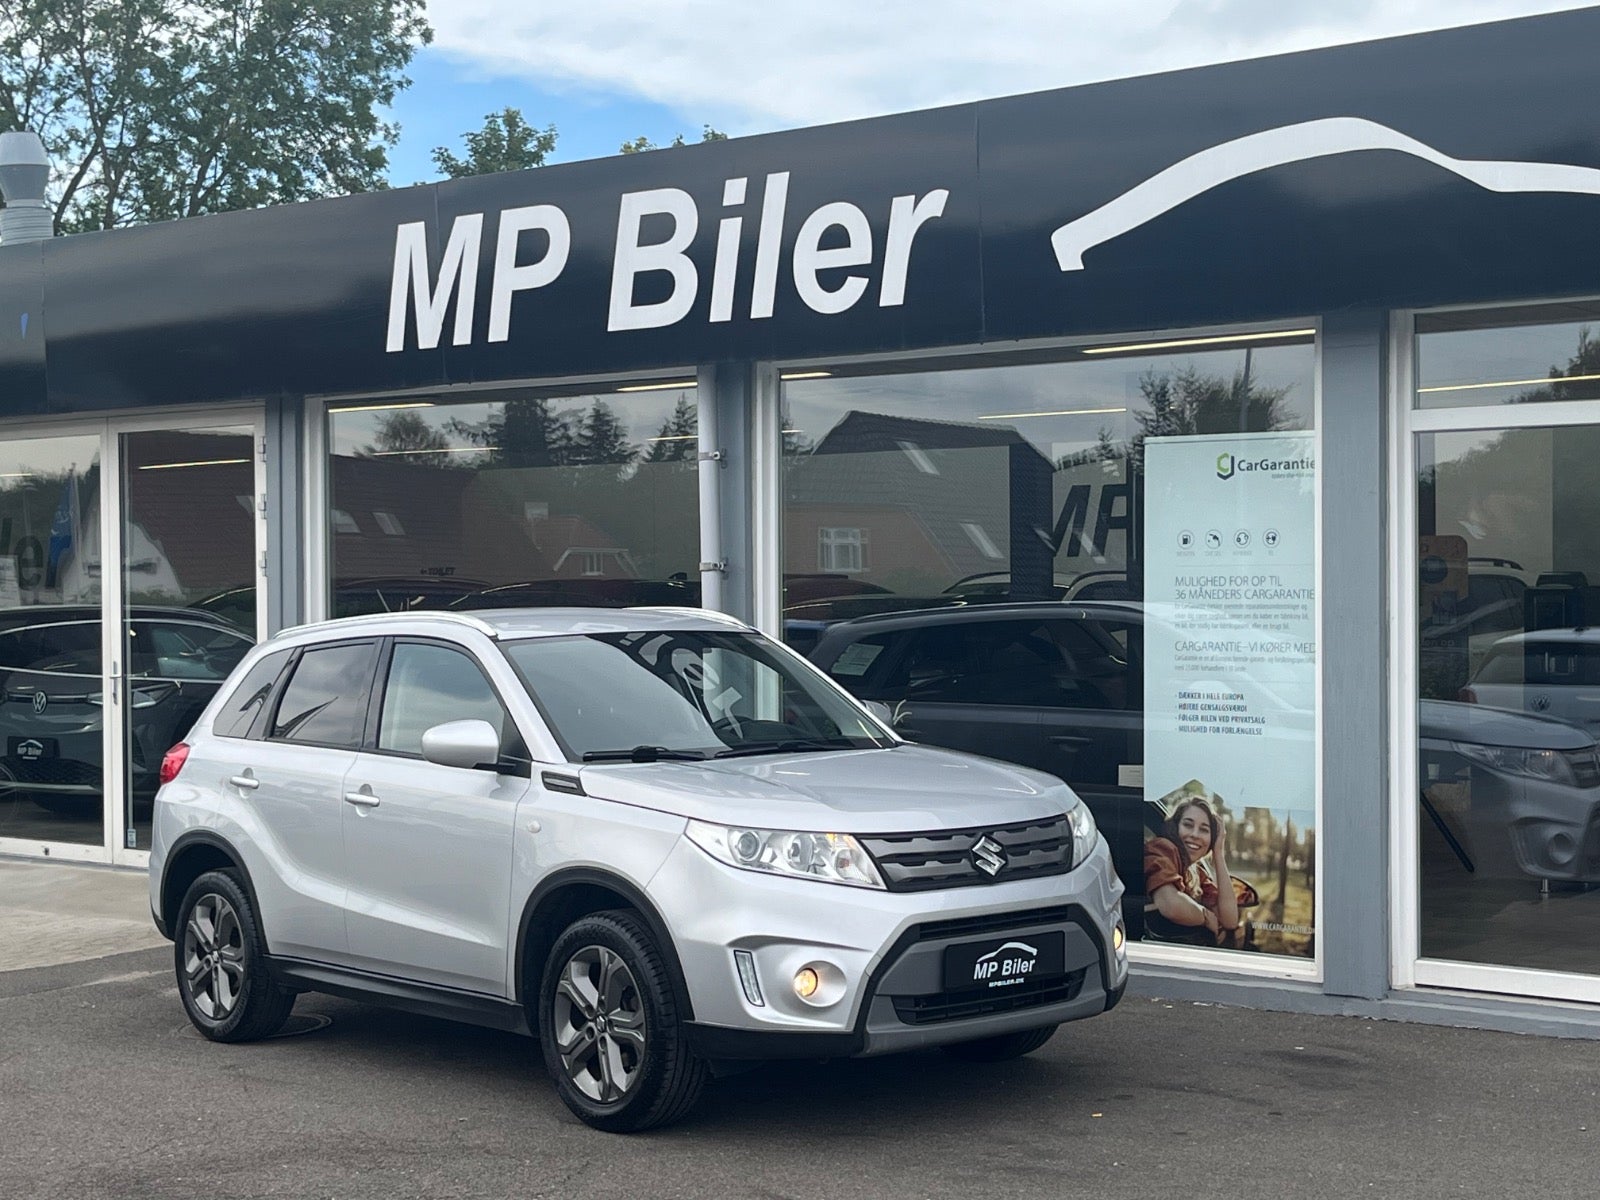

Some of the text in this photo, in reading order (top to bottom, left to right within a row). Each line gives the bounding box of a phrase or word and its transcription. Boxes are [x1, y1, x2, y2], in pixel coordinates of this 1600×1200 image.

[386, 171, 949, 353] MP Biler
[1238, 457, 1315, 472] CarGarantie
[1175, 576, 1282, 587] MULIGHED FOR OP TIL
[1175, 587, 1315, 600] 36 MÅNEDERS CARGARANTIE
[1261, 641, 1291, 653] KØRER
[1294, 642, 1315, 654] MED
[1178, 691, 1201, 700] DÆKKER
[1206, 692, 1220, 700] HELE
[1222, 692, 1244, 701] EUROPA
[1178, 714, 1266, 725] FØLGER BILEN VED PRIVATSALG
[1178, 725, 1263, 735] MULIGHED FOR FORLÆNGELSE
[974, 958, 1036, 980] MP Biler
